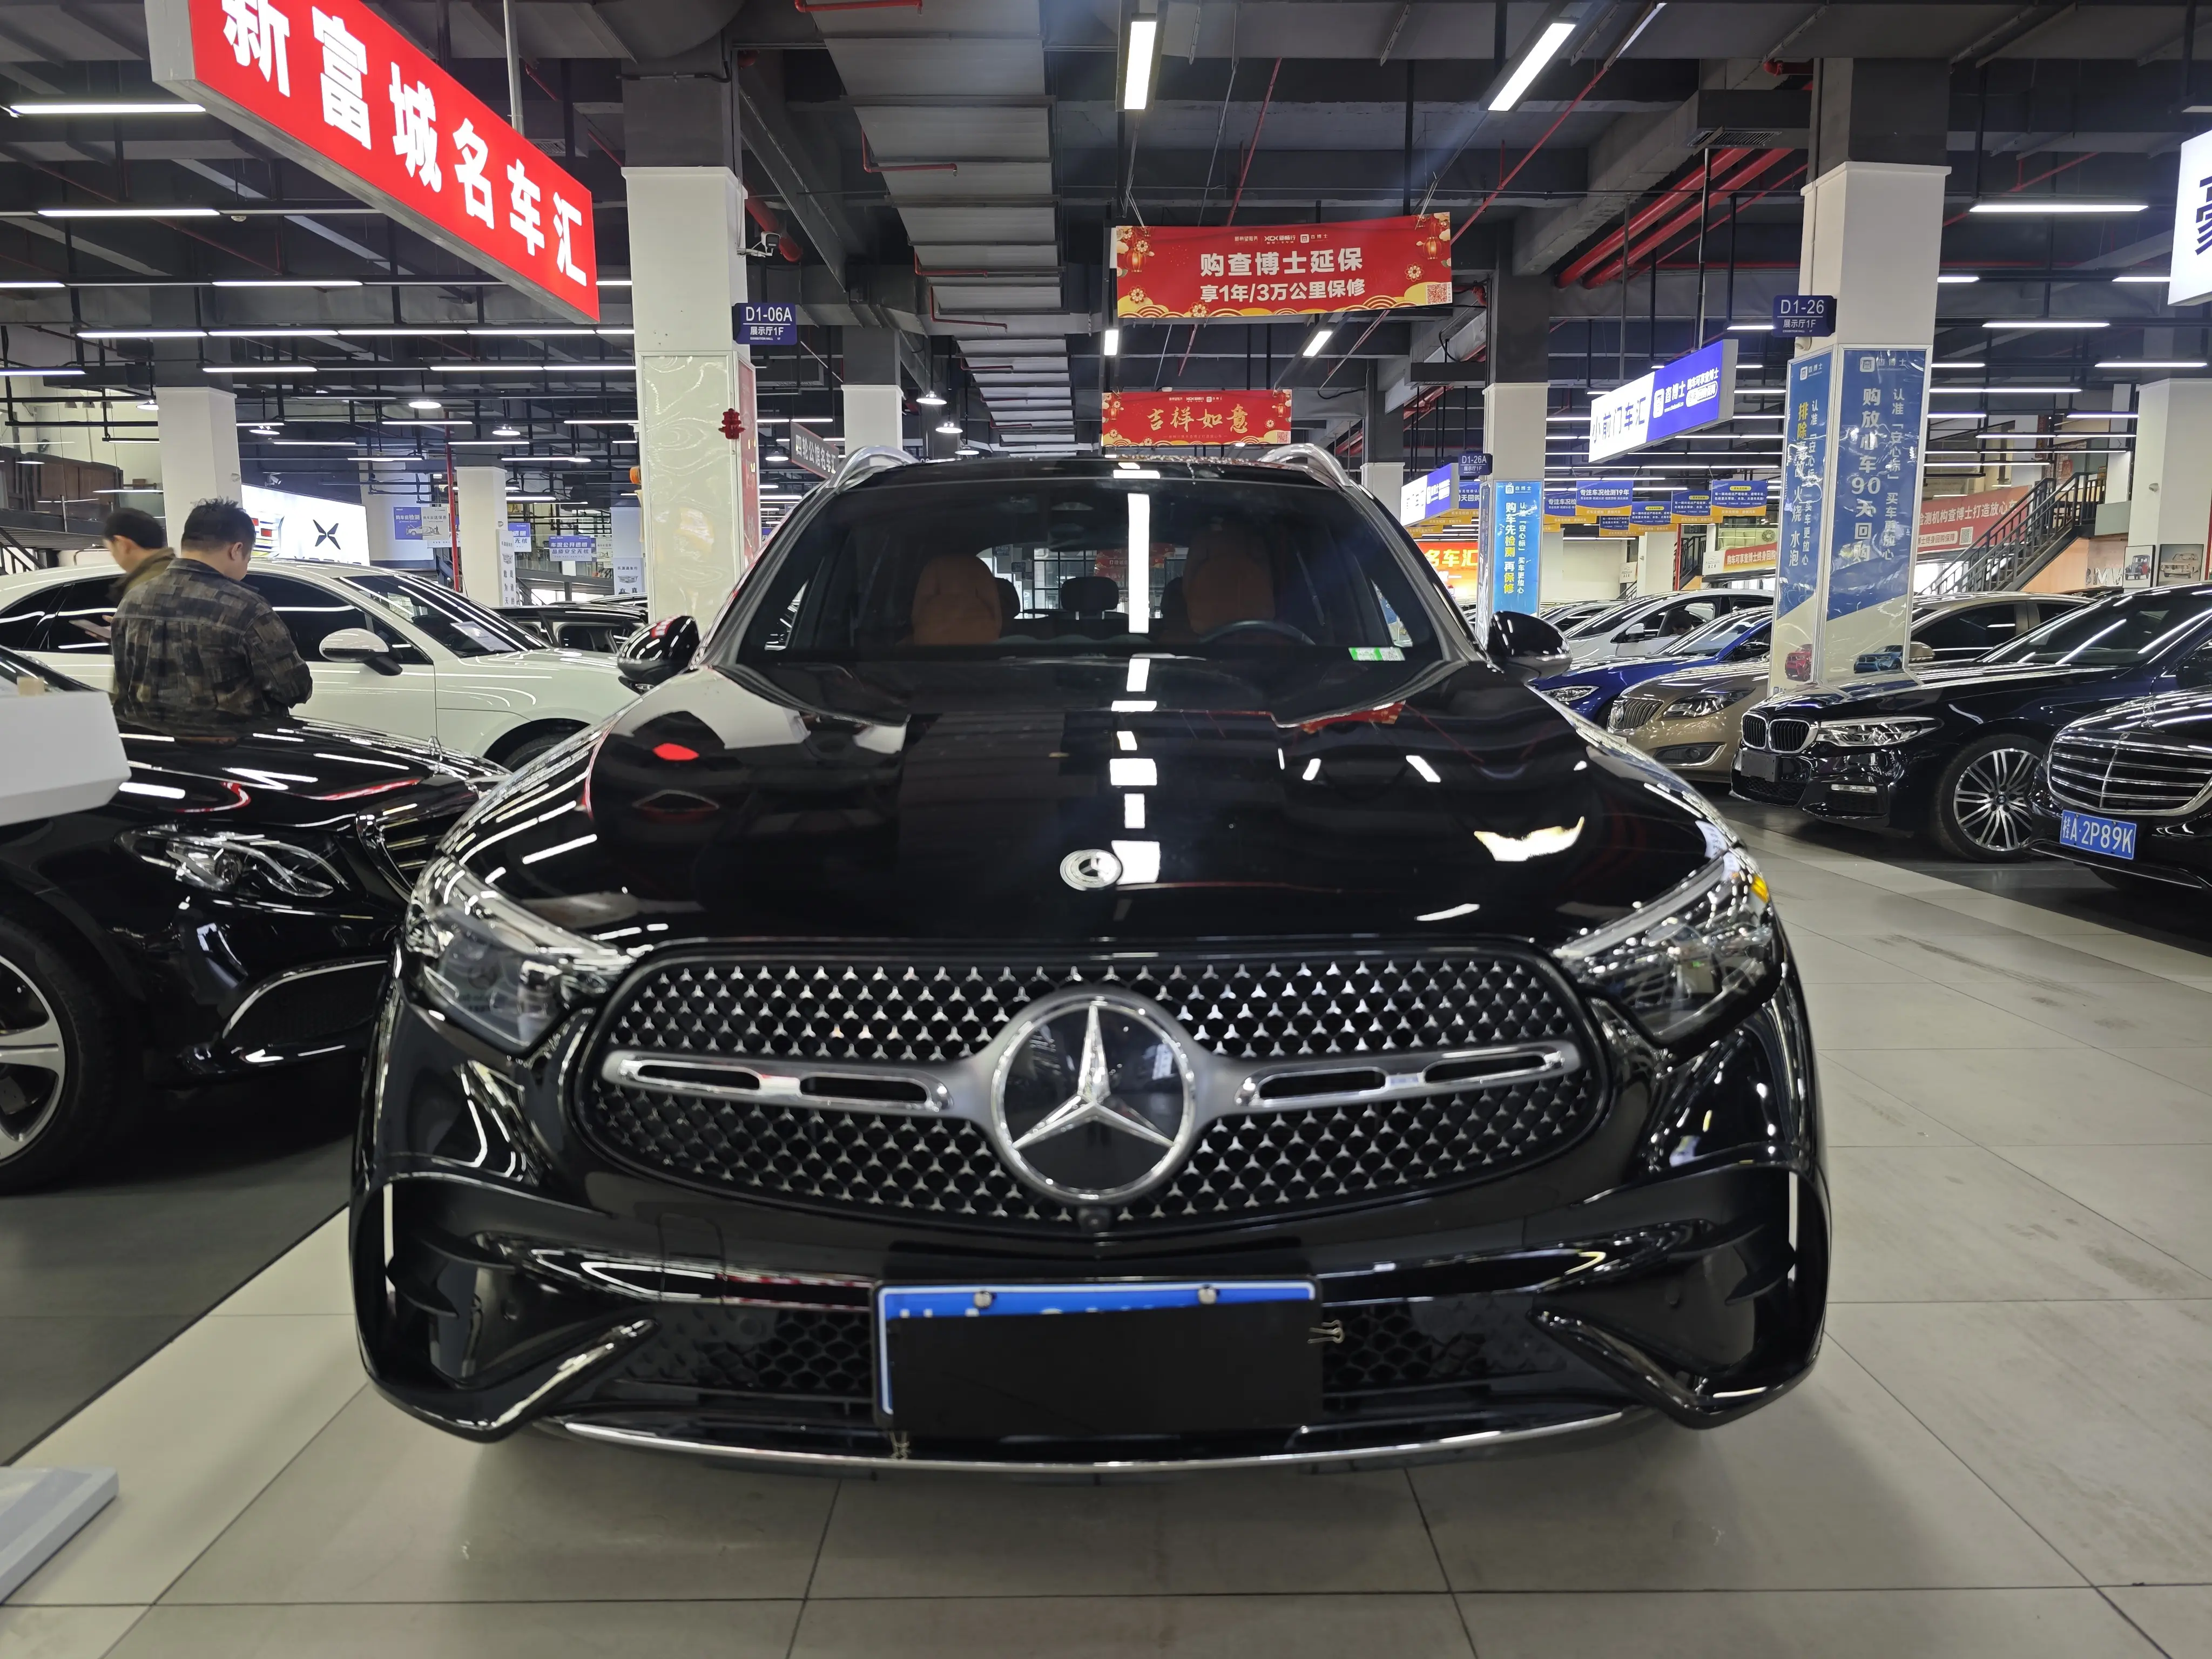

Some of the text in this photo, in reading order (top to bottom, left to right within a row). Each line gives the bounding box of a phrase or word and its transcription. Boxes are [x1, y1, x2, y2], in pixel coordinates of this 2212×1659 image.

[222, 0, 588, 287] 新富城名车汇
[1201, 247, 1363, 276] 购查博士延保
[1201, 279, 1365, 302] 享1年/3万公里保修
[746, 307, 792, 321] D1-06A
[1781, 300, 1824, 314] D1-26
[750, 327, 784, 335] 展示厅1F
[1783, 319, 1816, 328] 展示厅1F
[1665, 381, 1685, 403] 查博士
[1147, 403, 1248, 434] 吉祥如意
[1592, 396, 1646, 443] 小前门车汇
[1462, 455, 1487, 463] D1-26A
[1852, 388, 1881, 562] 购放心车90天回购
[1791, 486, 1803, 523] 火烧
[1504, 502, 1516, 557] 购车先检测
[1881, 493, 1898, 560] 买车更放心
[1425, 549, 1478, 567] 名车汇
[1727, 550, 1776, 565] 购车可享查博士终身回购
[1789, 530, 1800, 567] 水泡
[1503, 561, 1515, 594] 再保修
[1517, 557, 1525, 594] 买车更放心
